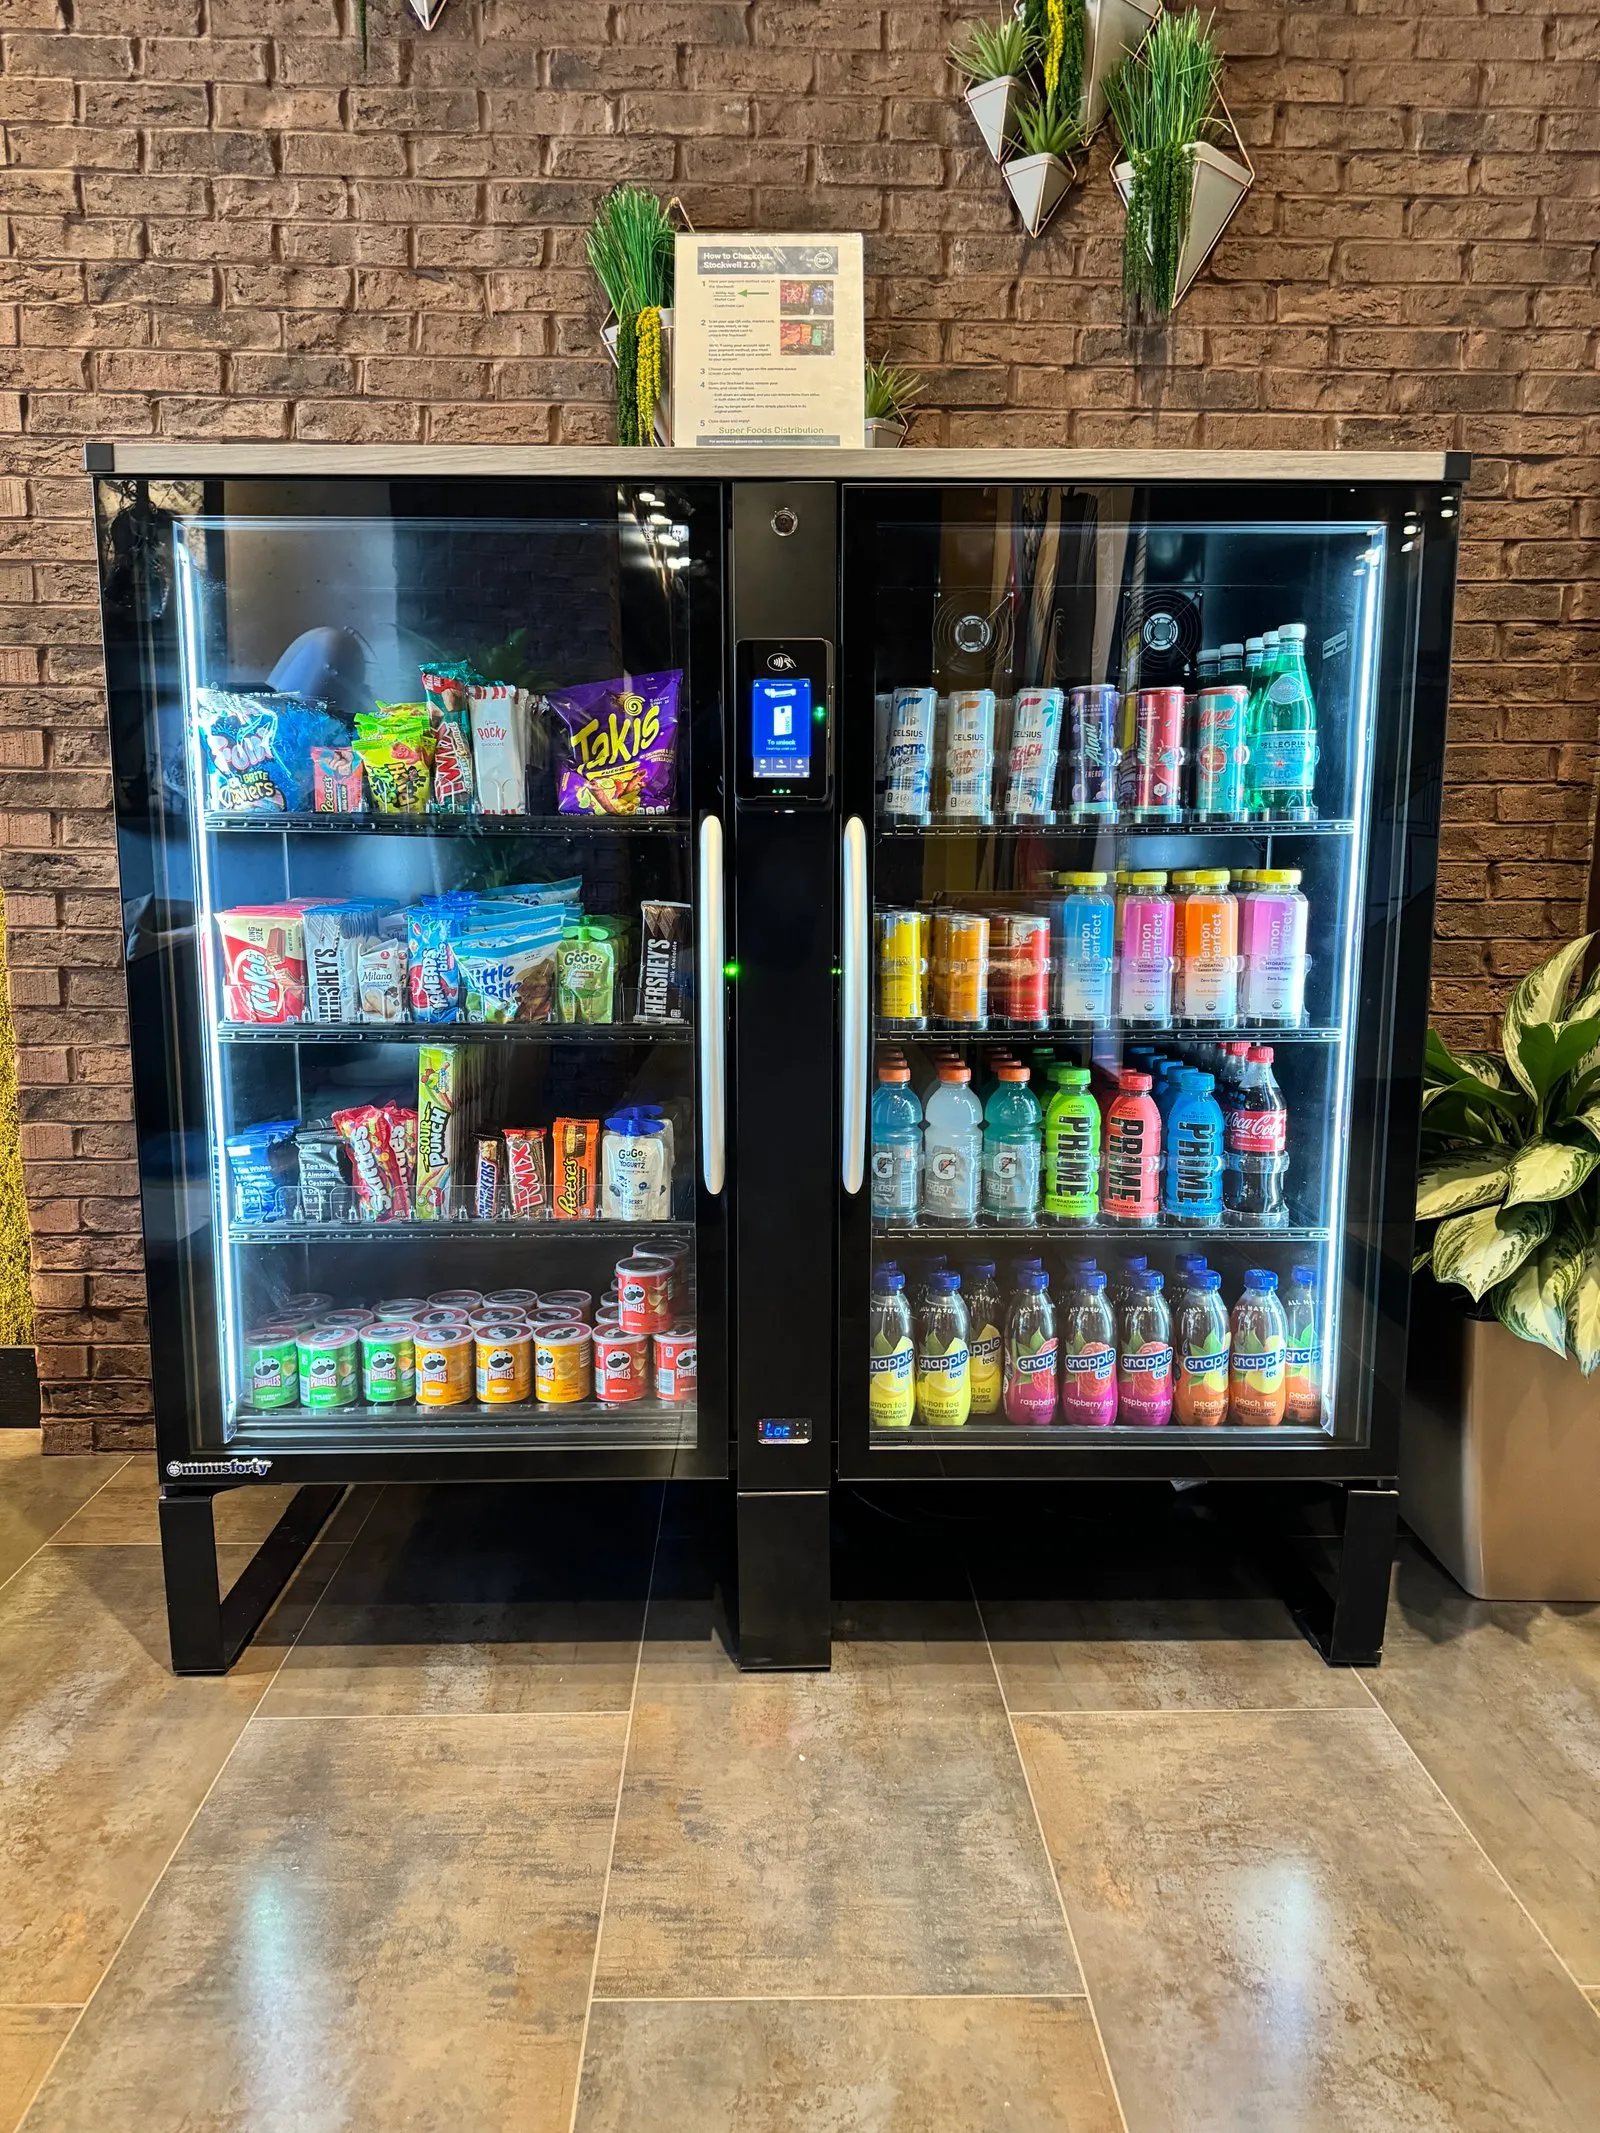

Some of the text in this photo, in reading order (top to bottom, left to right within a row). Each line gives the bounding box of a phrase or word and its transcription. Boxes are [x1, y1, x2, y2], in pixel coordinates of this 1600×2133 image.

[703, 252, 731, 260] How to
[477, 725, 507, 741] POCKY
[570, 704, 660, 774] Takis
[893, 729, 924, 738] CELSIUS
[953, 733, 985, 741] CELSIUS
[1013, 730, 1042, 739] CELSIUS
[889, 744, 926, 757] ARCTIC
[433, 722, 467, 806] TWIX
[601, 766, 626, 776] FUEGO
[248, 926, 256, 942] KING
[256, 927, 264, 942] SIZE
[437, 942, 448, 972] bites
[564, 951, 597, 966] GoGo
[361, 971, 392, 982] Milano
[644, 938, 671, 1015] HERSHEY'S
[1229, 1111, 1281, 1136] Coca-Cola
[420, 1120, 432, 1155] SOUR
[429, 1106, 452, 1168] PUNCH
[618, 1148, 643, 1160] GoGo
[1056, 1115, 1092, 1197] PRIME
[1108, 1116, 1145, 1203] PRIME
[619, 1161, 646, 1169] YOGURTZ
[872, 1152, 895, 1179] G
[932, 1153, 956, 1180] G
[992, 1152, 1016, 1179] G
[1177, 1121, 1216, 1204] PRIME
[511, 1142, 544, 1218] TWIX
[557, 1156, 578, 1216] Reese's
[926, 1184, 952, 1193] FROST
[986, 1183, 1011, 1193] FROST
[623, 1302, 645, 1314] PRINGLES
[870, 1348, 914, 1373] napple
[920, 1348, 970, 1373] snapple
[981, 1356, 995, 1365] tea
[1067, 1349, 1115, 1371] snapple
[1123, 1349, 1172, 1371] snapple
[1188, 1351, 1229, 1371] snapp
[1233, 1349, 1285, 1370] snappe
[1286, 1349, 1321, 1365] snap
[488, 1366, 514, 1381] PRINGLES
[606, 1366, 631, 1380] PRINGLES
[897, 1369, 910, 1379] tea
[949, 1369, 963, 1379] tea
[1097, 1369, 1110, 1379] tea
[1155, 1368, 1167, 1378] tea
[977, 1386, 991, 1394] tea
[1289, 1391, 1316, 1400] peach
[946, 1400, 960, 1408] tea
[1103, 1398, 1114, 1407] tea
[1161, 1398, 1171, 1407] tea
[1193, 1399, 1218, 1408] peach
[1235, 1397, 1277, 1407] peach tea
[181, 1459, 271, 1475] minusforty
